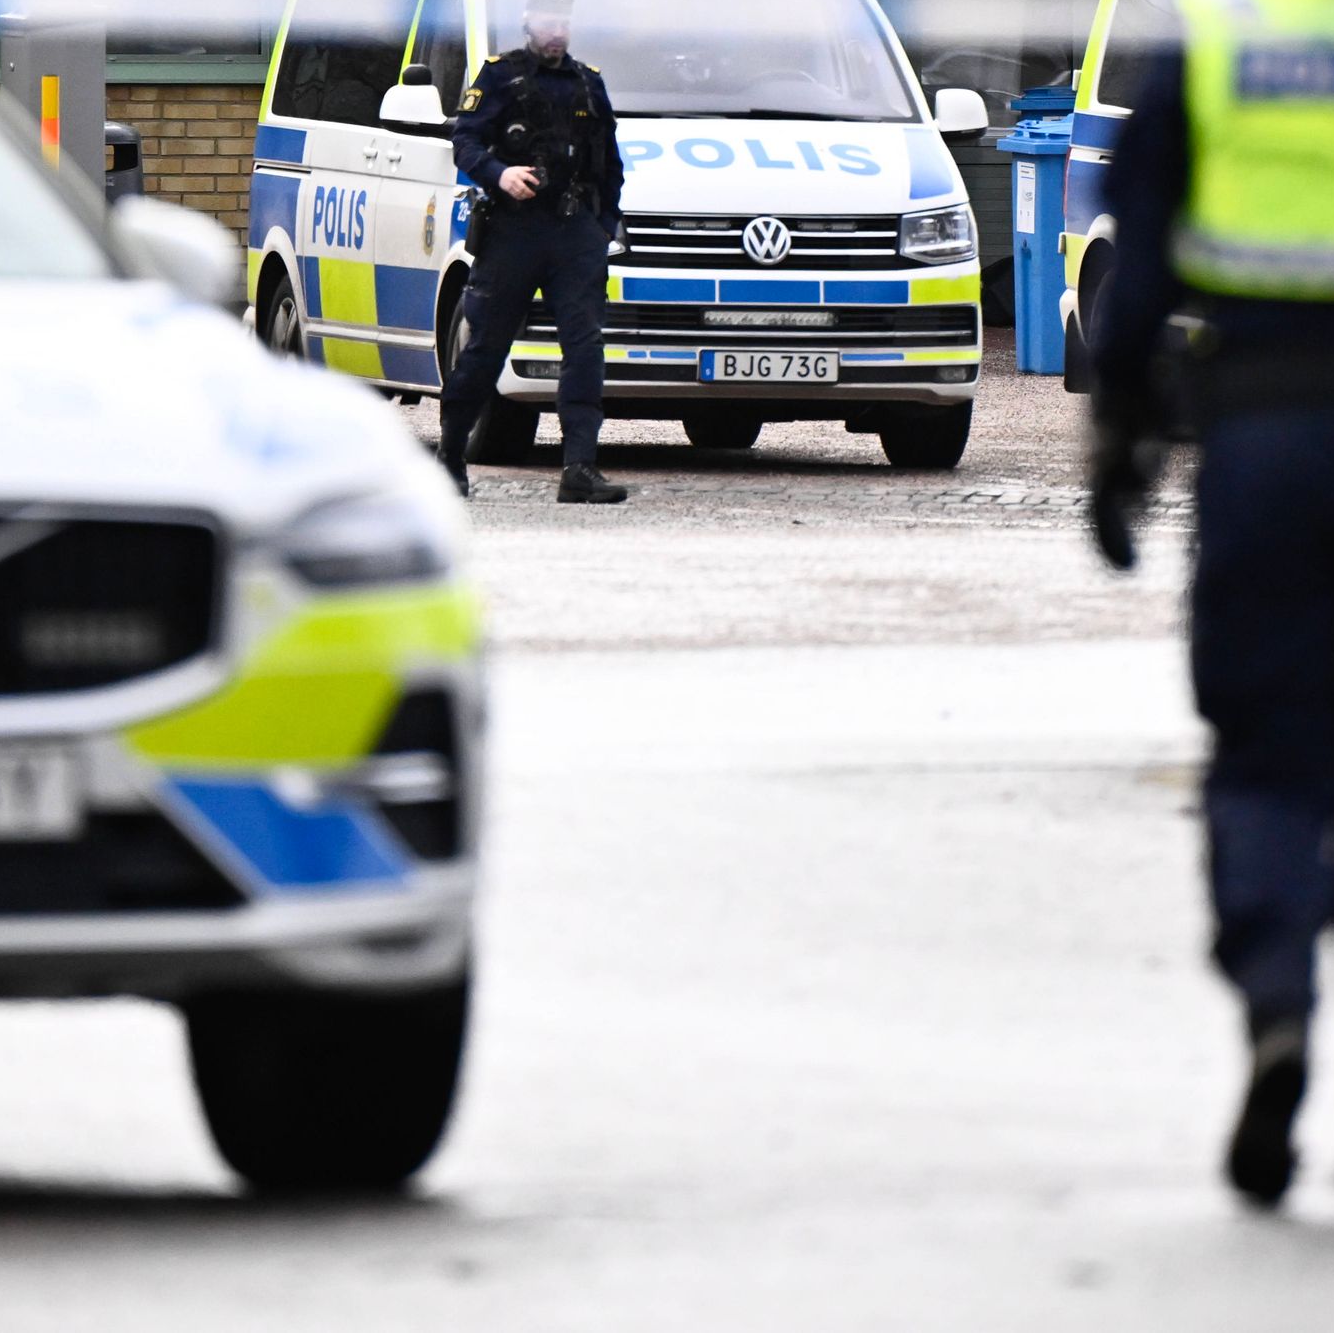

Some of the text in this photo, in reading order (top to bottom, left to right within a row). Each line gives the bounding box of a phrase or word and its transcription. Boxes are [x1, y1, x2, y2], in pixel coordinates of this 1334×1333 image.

[617, 137, 882, 177] POLIS
[312, 185, 368, 250] POLIS
[723, 354, 828, 379] BJG 73G
